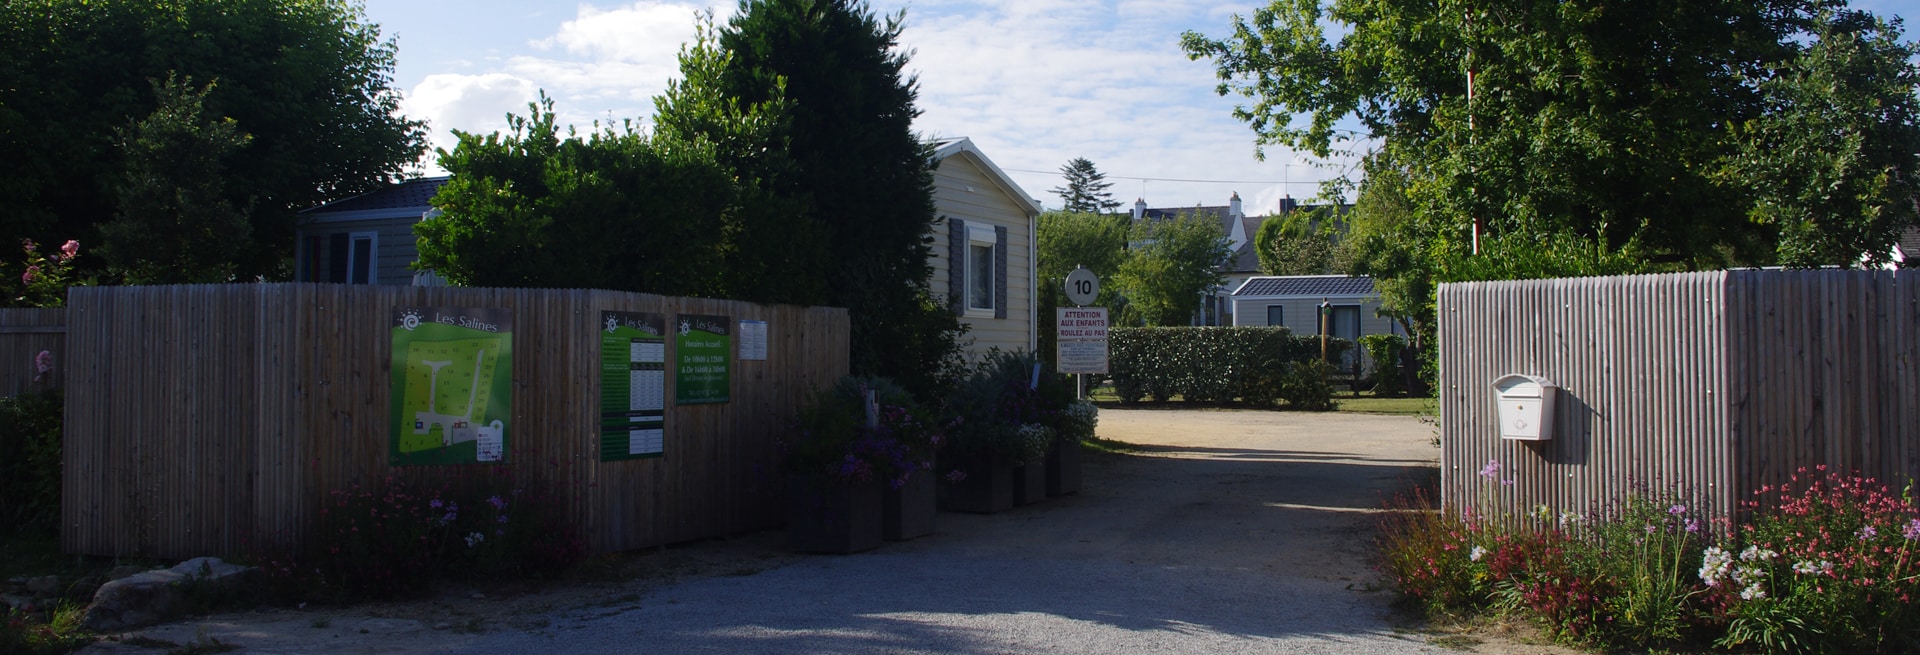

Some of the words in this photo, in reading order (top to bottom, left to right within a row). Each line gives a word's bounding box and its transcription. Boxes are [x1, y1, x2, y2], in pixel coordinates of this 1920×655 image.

[1075, 280, 1091, 294] 10
[435, 312, 455, 325] Les
[458, 315, 498, 332] Salines
[625, 316, 636, 328] Les
[637, 320, 658, 336] Salines
[696, 319, 706, 330] Les
[1060, 319, 1074, 327] AUX
[1076, 319, 1105, 327] ENFANTS
